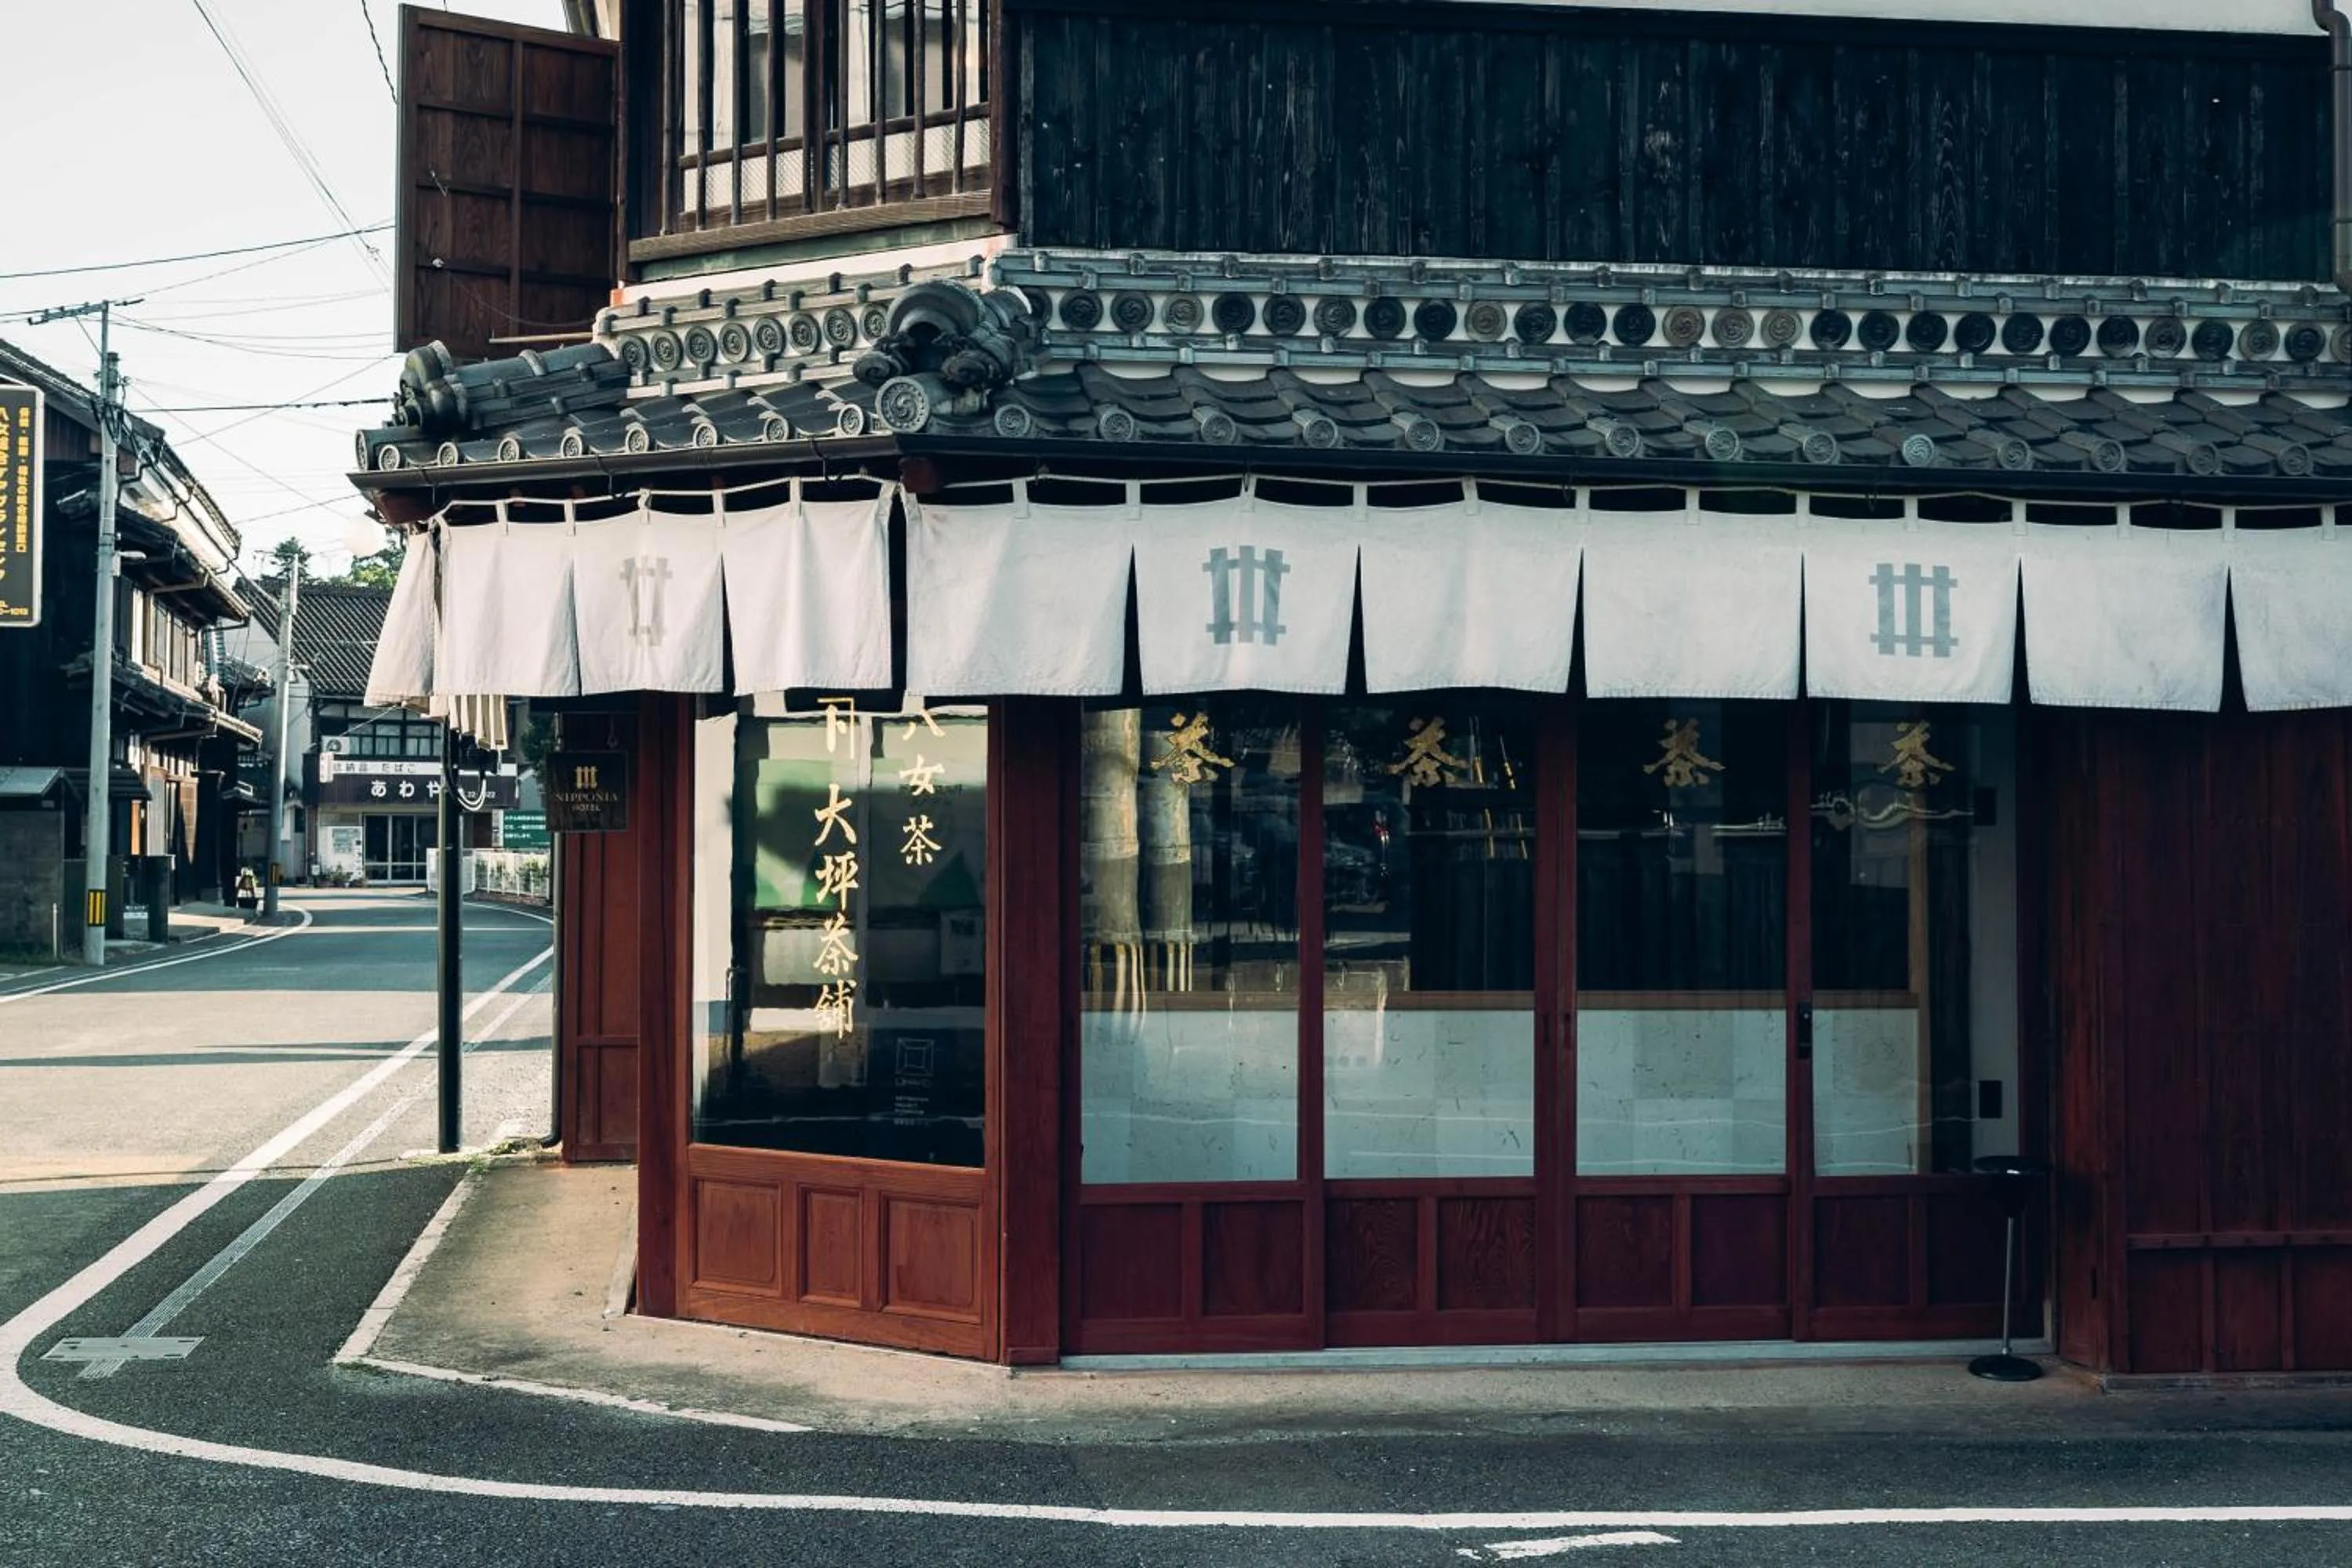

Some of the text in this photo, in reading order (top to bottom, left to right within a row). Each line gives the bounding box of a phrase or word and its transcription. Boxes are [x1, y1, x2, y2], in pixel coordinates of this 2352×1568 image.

[899, 708, 946, 866] 八女茶
[814, 784, 858, 1040] 大坪茶舗
